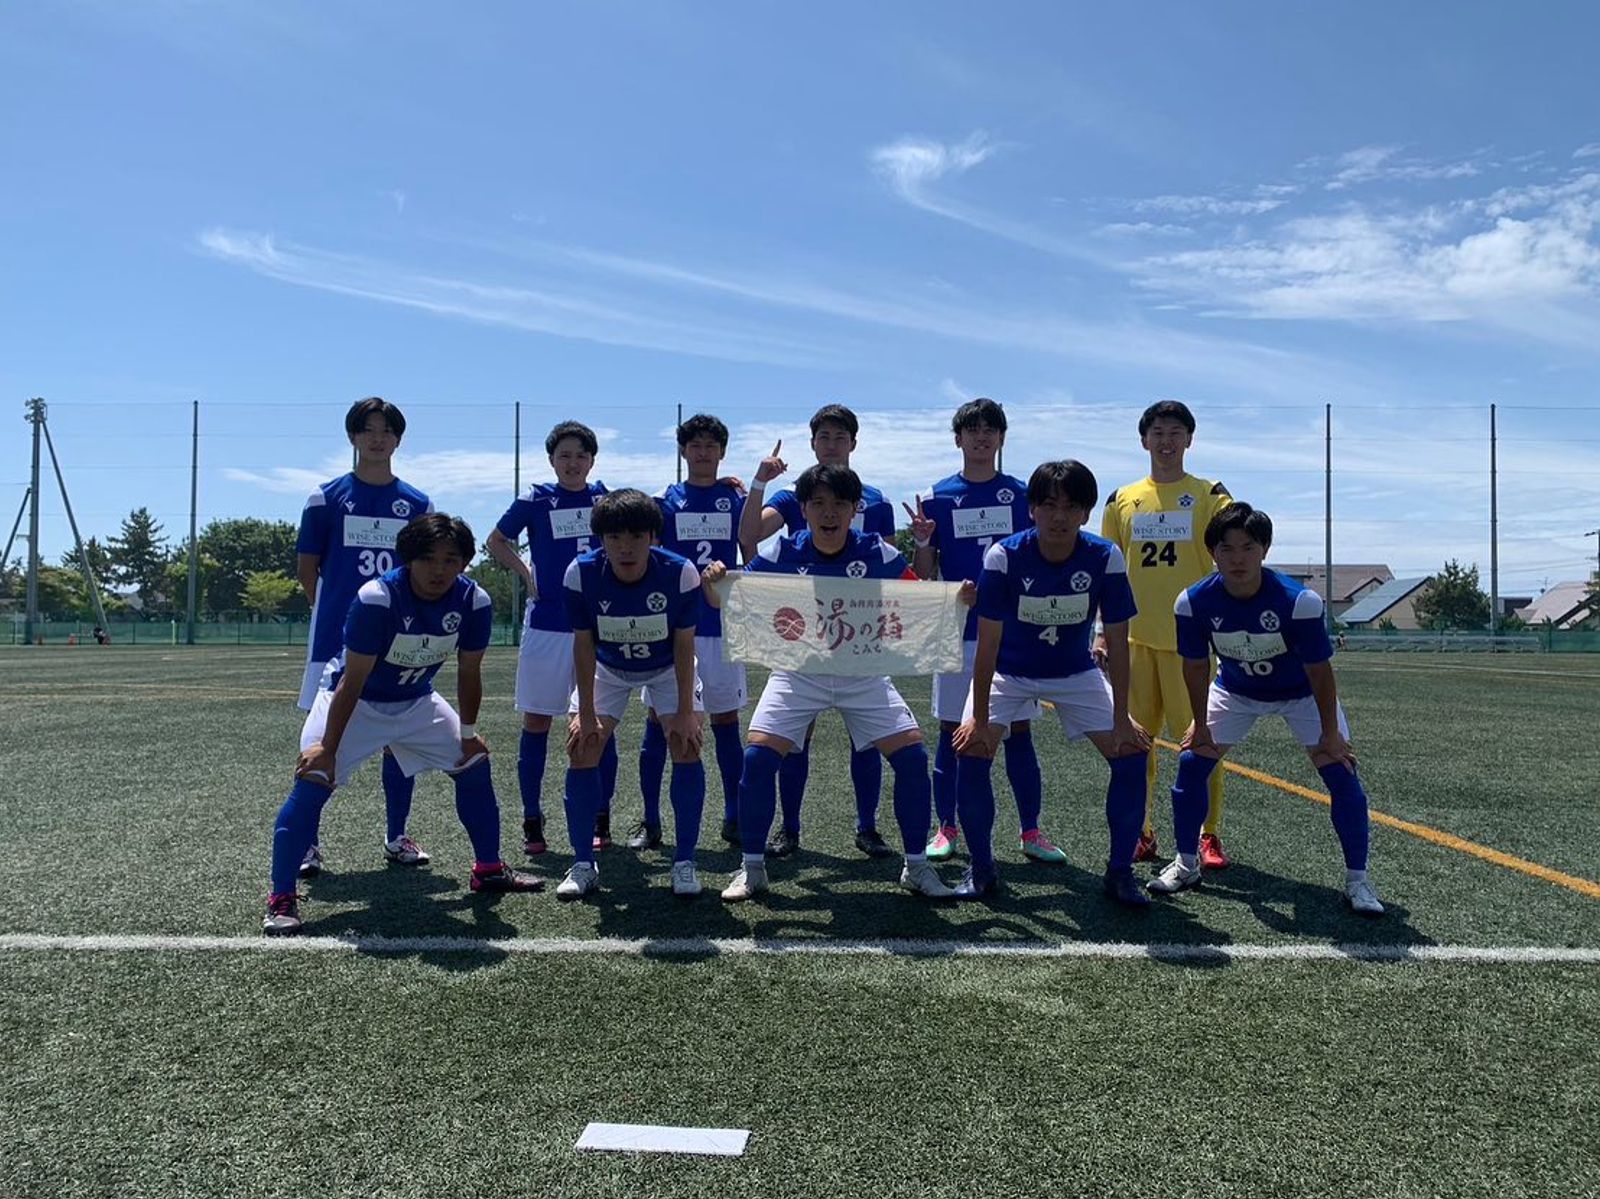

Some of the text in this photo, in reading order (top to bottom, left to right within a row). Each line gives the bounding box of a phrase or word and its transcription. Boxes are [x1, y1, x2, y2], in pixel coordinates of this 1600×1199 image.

[1133, 526, 1189, 535] WISE STORY
[696, 541, 713, 565] 2
[1141, 541, 1178, 567] 24
[358, 549, 393, 577] 30
[1039, 625, 1059, 646] 4
[619, 643, 651, 659] 13
[397, 667, 427, 685] 11
[1239, 660, 1273, 676] 10
